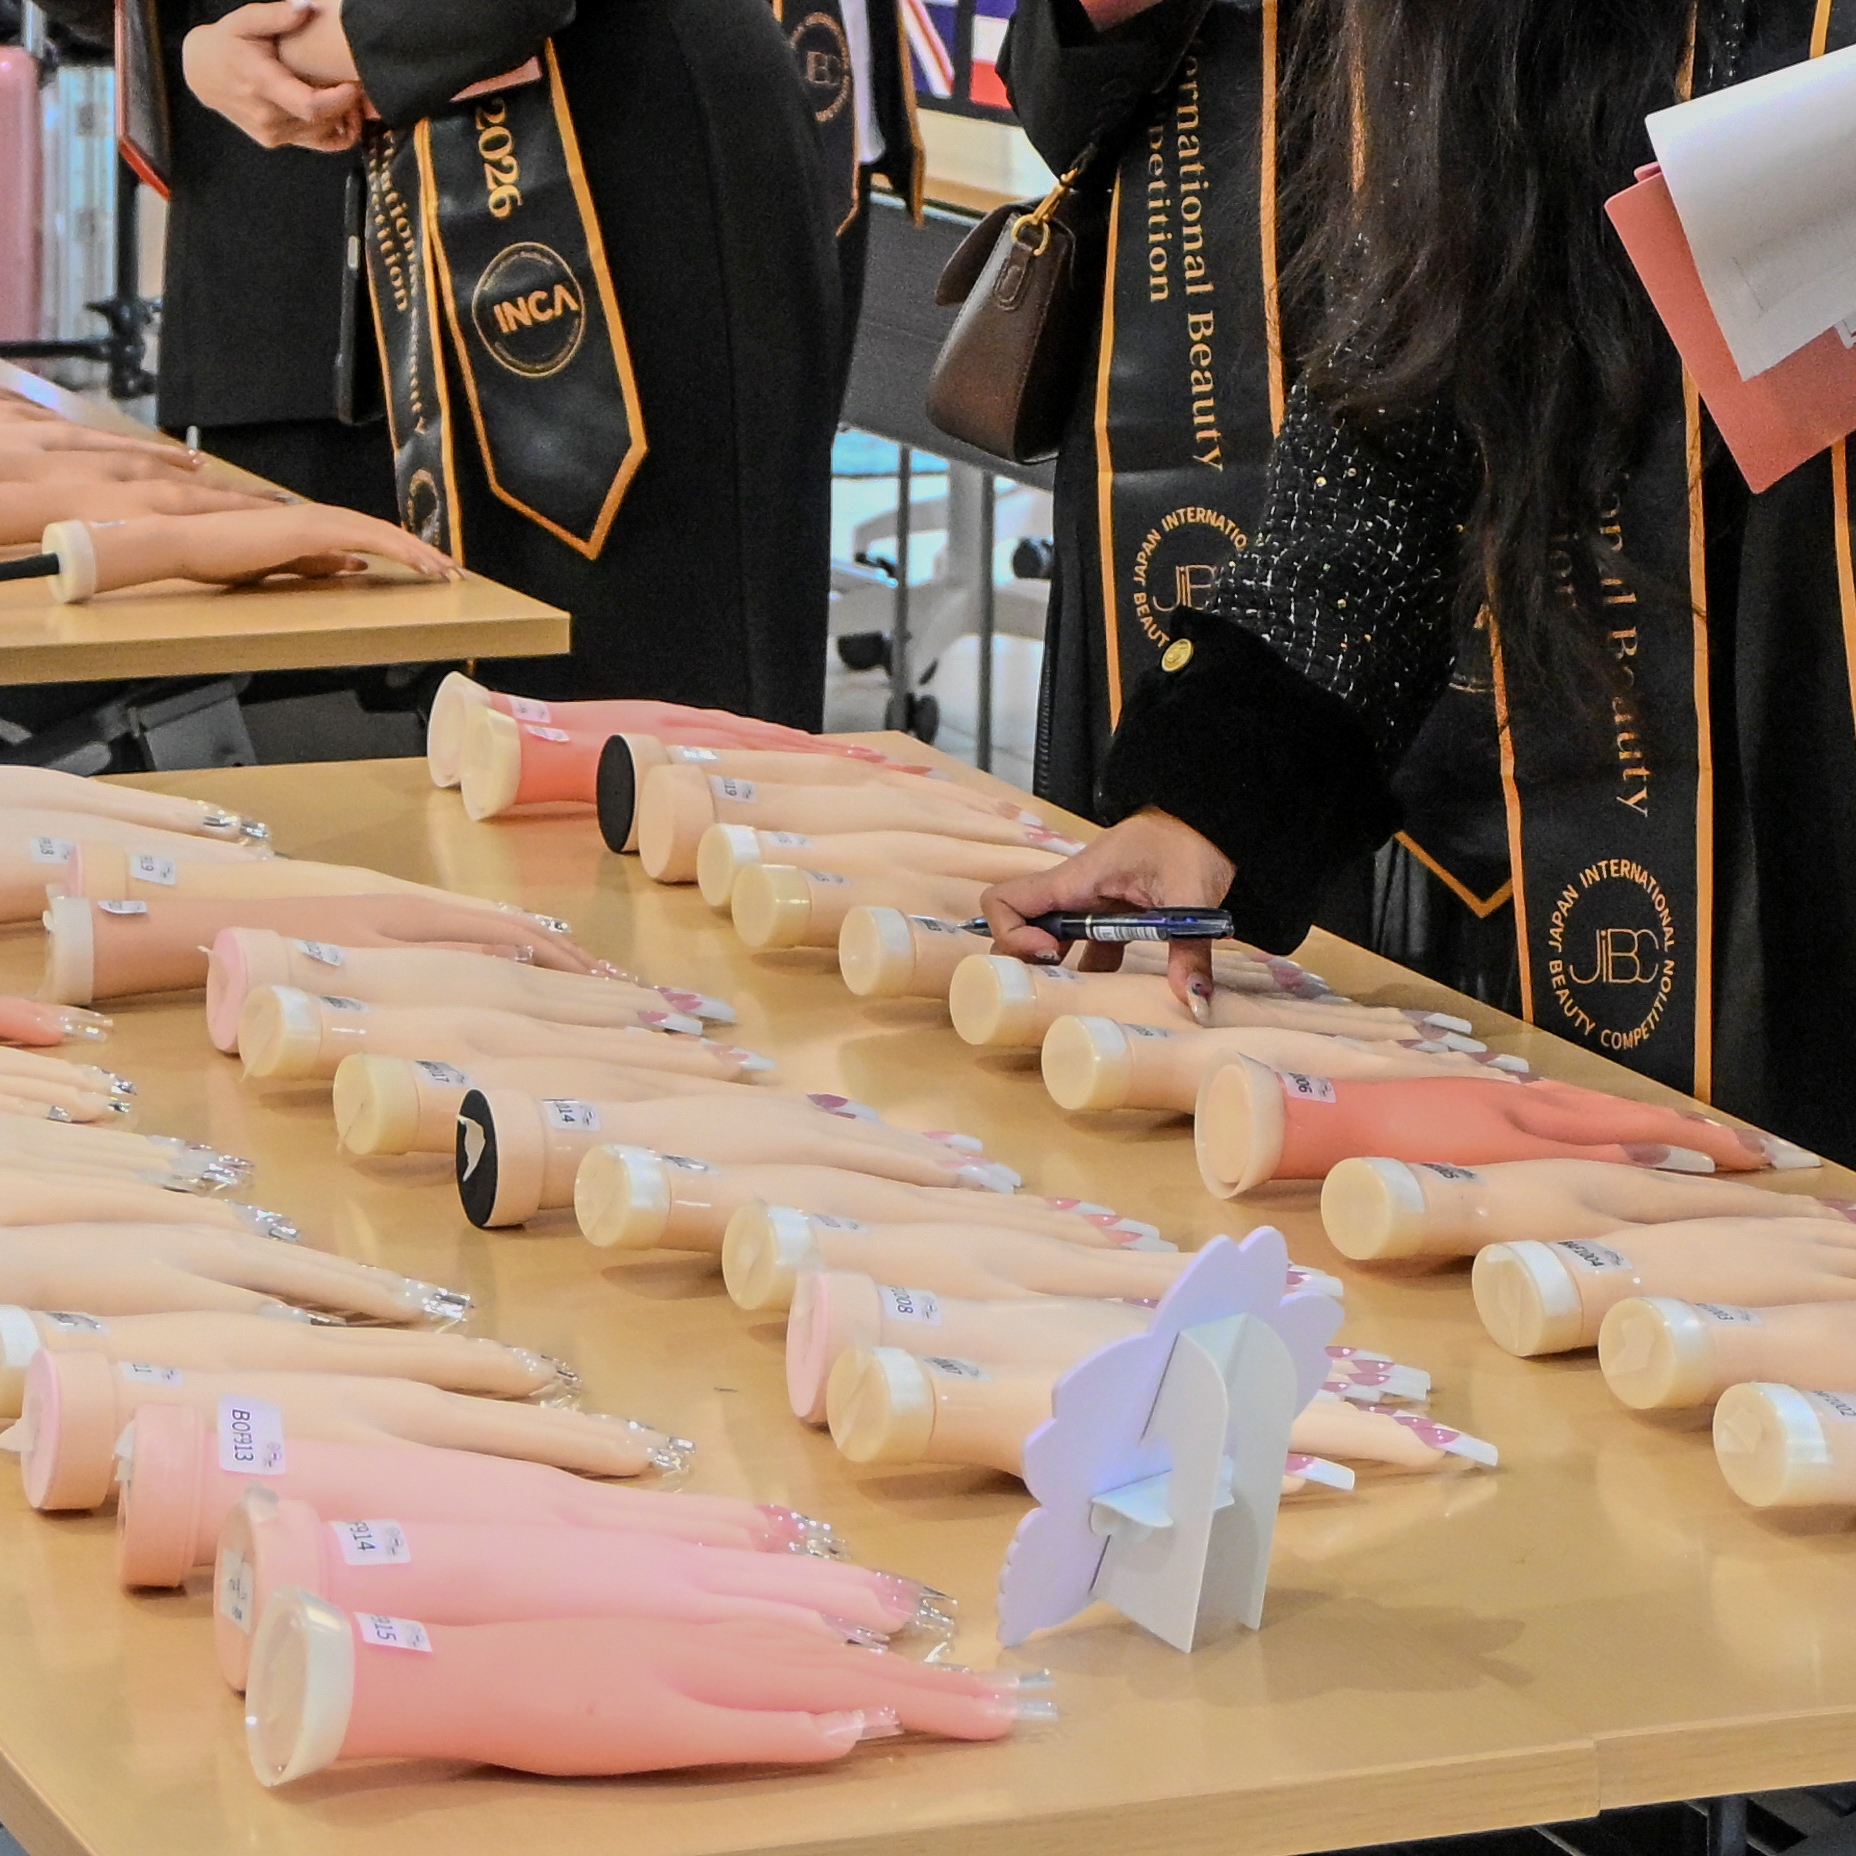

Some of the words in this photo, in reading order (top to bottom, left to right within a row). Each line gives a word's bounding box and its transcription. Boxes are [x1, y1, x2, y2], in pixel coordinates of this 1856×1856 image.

[475, 97, 524, 220] 2026
[493, 283, 580, 334] INCA
[1186, 310, 1224, 473] Beauty
[1132, 528, 1162, 587] JAPAN
[1548, 883, 1580, 954] JAPAN
[1579, 858, 1676, 954] INTERNATIONAL
[1548, 958, 1597, 1027] BEAUTY
[1600, 958, 1676, 1051] COMPETITION
